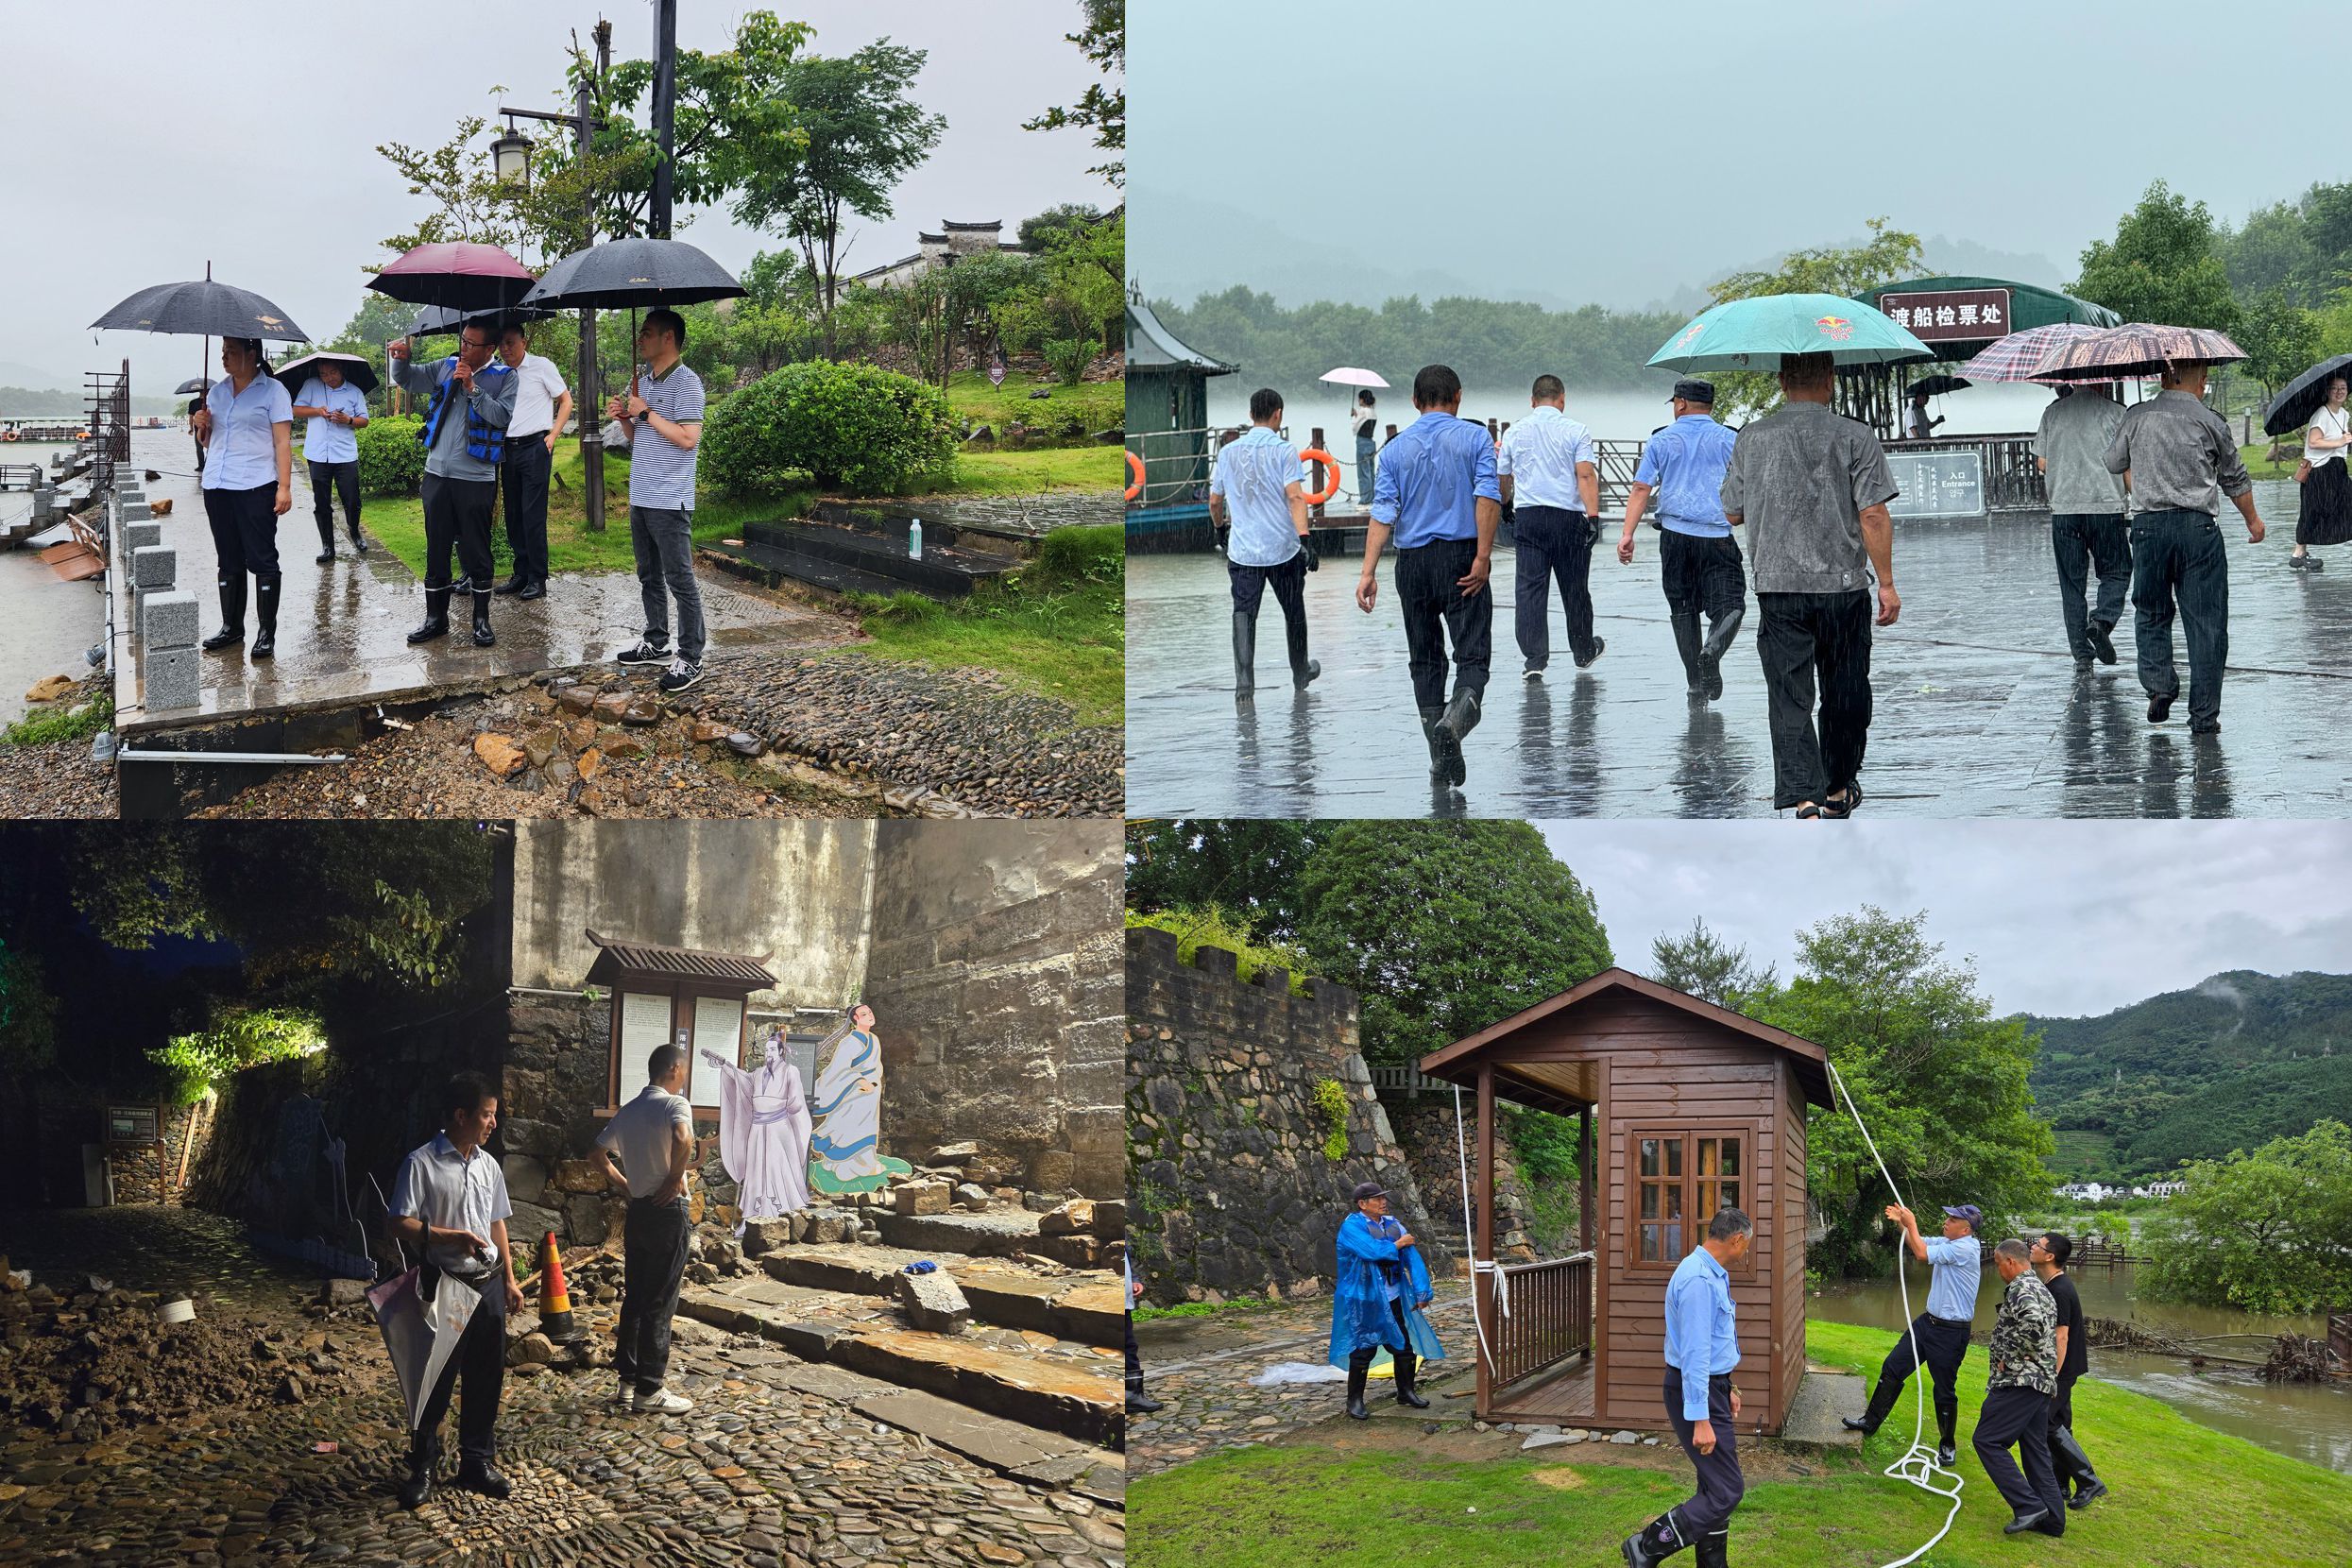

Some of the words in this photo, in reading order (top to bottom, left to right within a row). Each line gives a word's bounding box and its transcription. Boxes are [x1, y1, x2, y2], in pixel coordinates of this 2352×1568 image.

[1890, 304, 2002, 328] 渡船检票处
[1950, 471, 1965, 480] 入口
